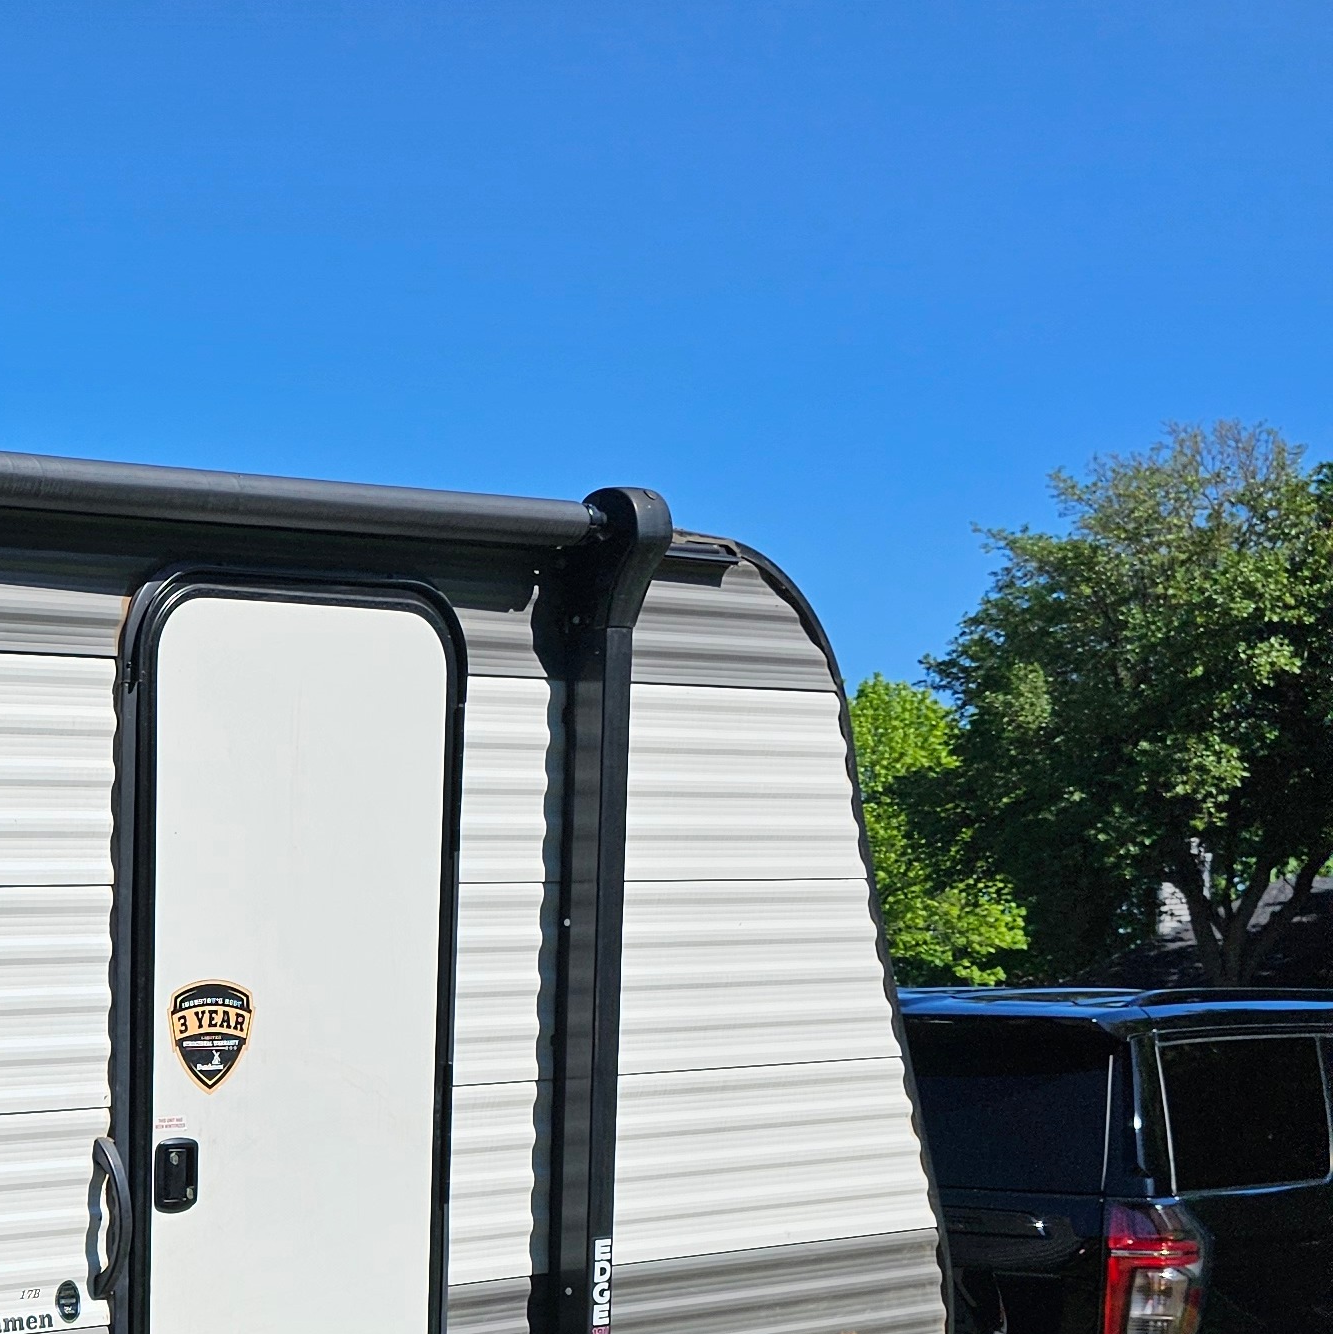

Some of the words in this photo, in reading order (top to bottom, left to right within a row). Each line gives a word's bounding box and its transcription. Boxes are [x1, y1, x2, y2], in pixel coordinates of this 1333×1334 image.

[177, 1014, 189, 1035] 3
[193, 1009, 246, 1033] YEAR
[592, 1238, 612, 1326] EDGE
